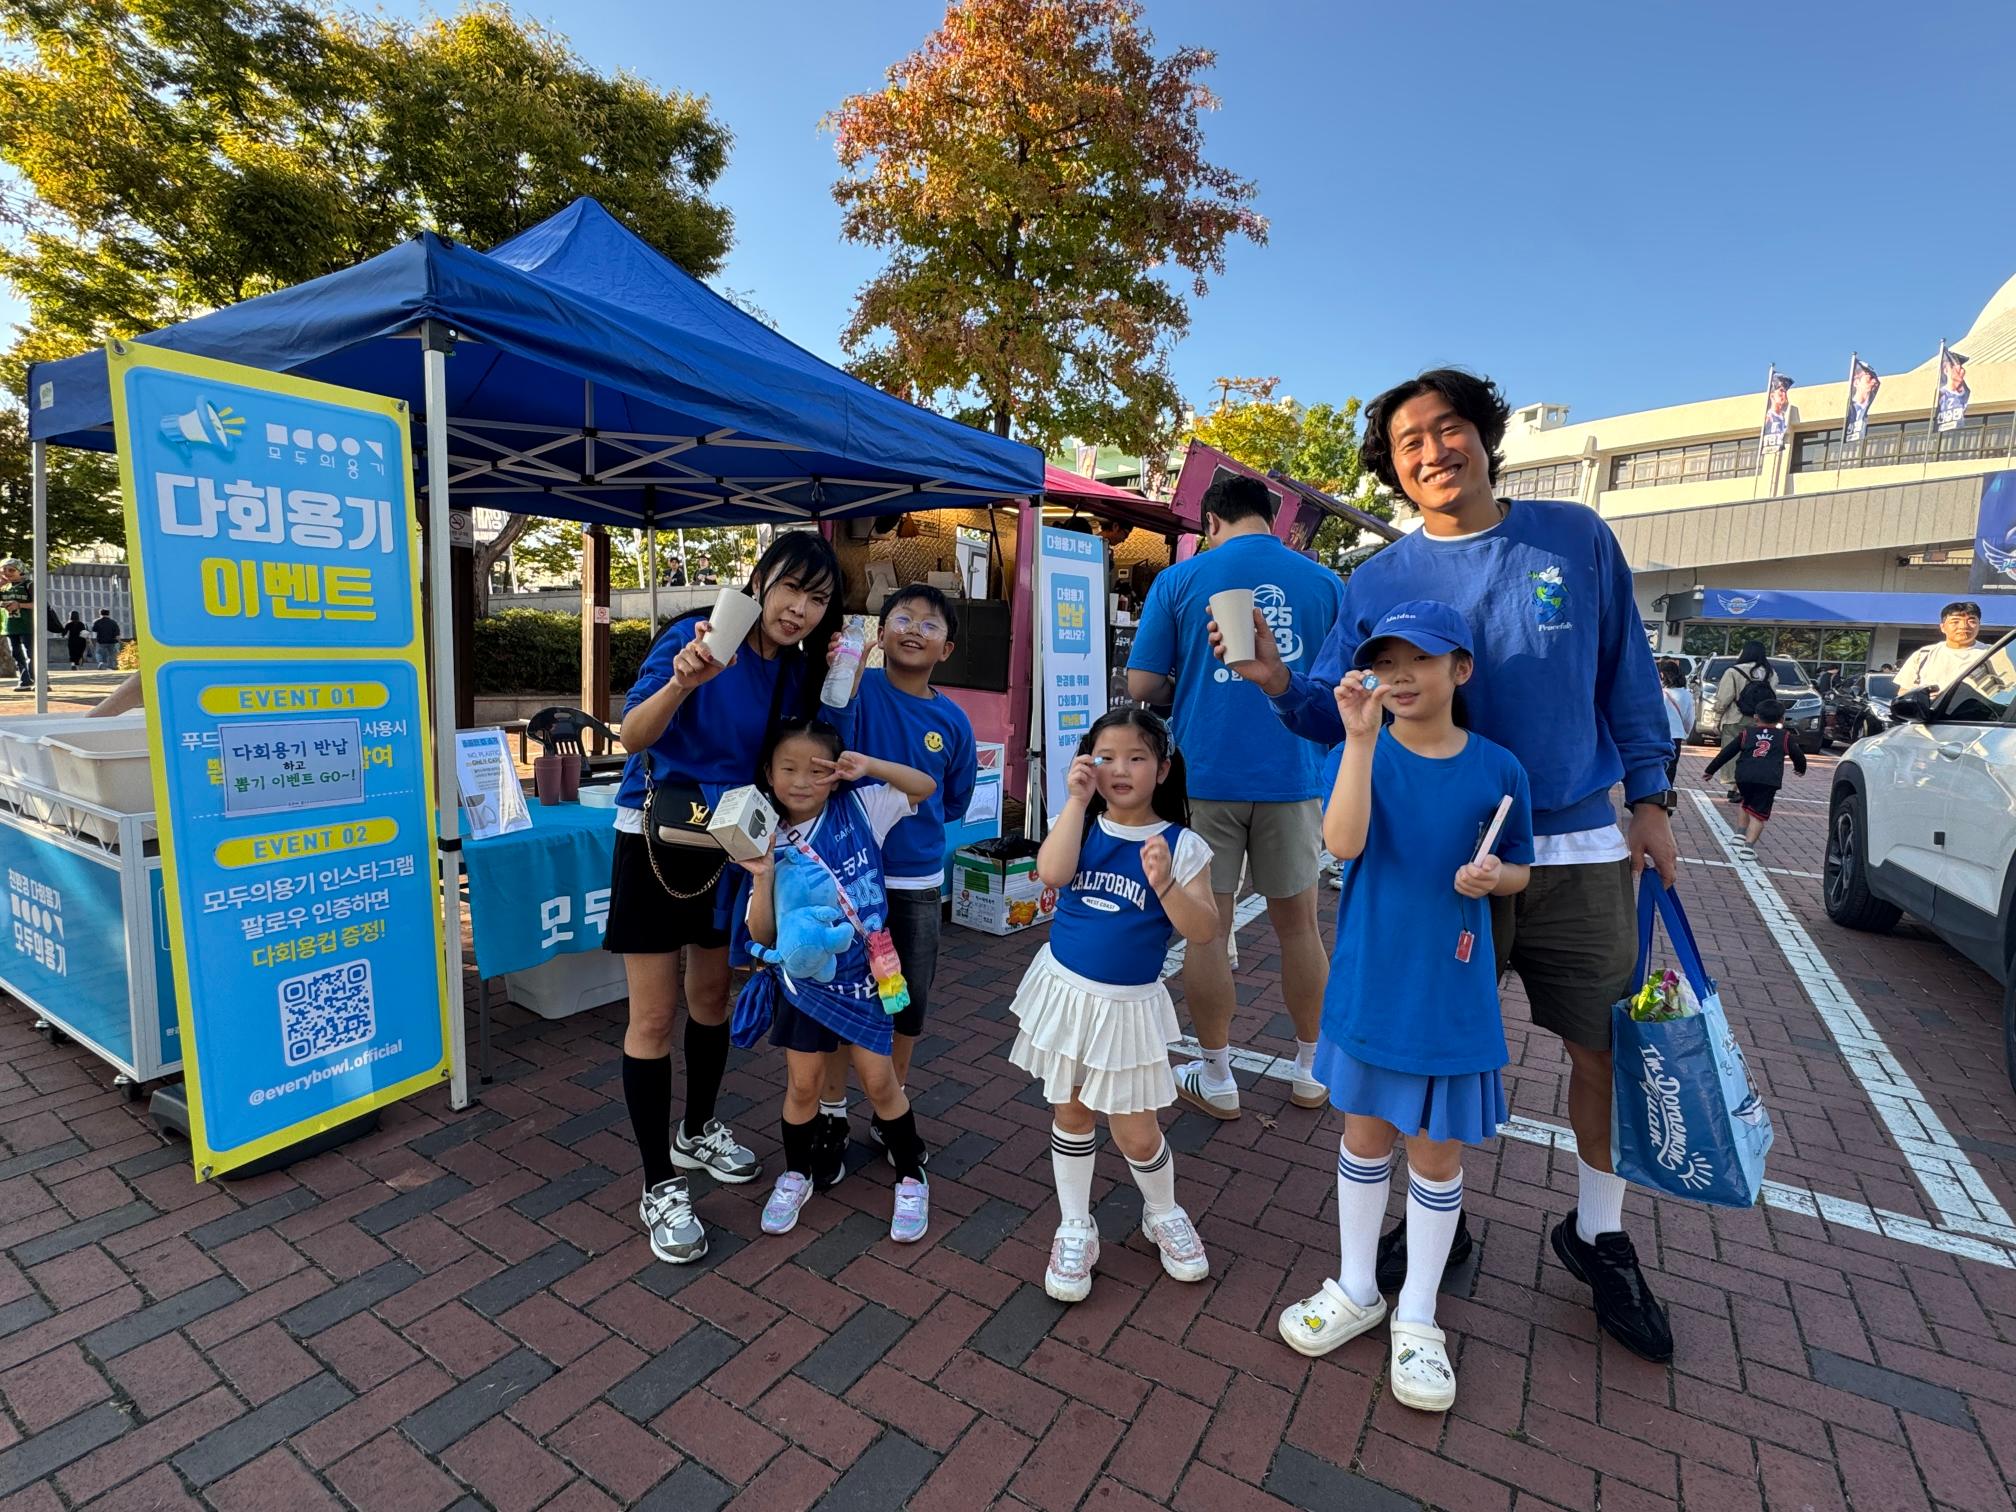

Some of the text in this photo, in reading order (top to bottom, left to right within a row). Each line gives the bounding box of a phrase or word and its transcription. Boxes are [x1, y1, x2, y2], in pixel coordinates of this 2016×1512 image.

[155, 472, 394, 553] 다회용기
[1046, 535, 1092, 555] 다회용기 반납
[201, 557, 377, 621] 이벤트
[1056, 587, 1084, 602] 다회용기
[1057, 602, 1085, 628] 반납
[239, 687, 355, 709] EVENT 01
[365, 719, 408, 738] 사용시
[232, 737, 348, 762] 다회용기 반납
[282, 760, 306, 771] 하고
[1752, 740, 1771, 758] 2
[234, 769, 356, 793] 뽑기 이벤트 GO~!
[253, 825, 368, 860] EVENT 02
[203, 854, 415, 914] 모두의용기 인스타그램
[1071, 870, 1147, 912] CALIFORNIA
[241, 888, 391, 941] 팔로우 인증하면
[14, 920, 67, 977] 모두의용기
[252, 919, 386, 968] 다회용컵 증정!
[249, 1038, 403, 1106] @everybowl.official
[1655, 1075, 1687, 1169] Doraemon
